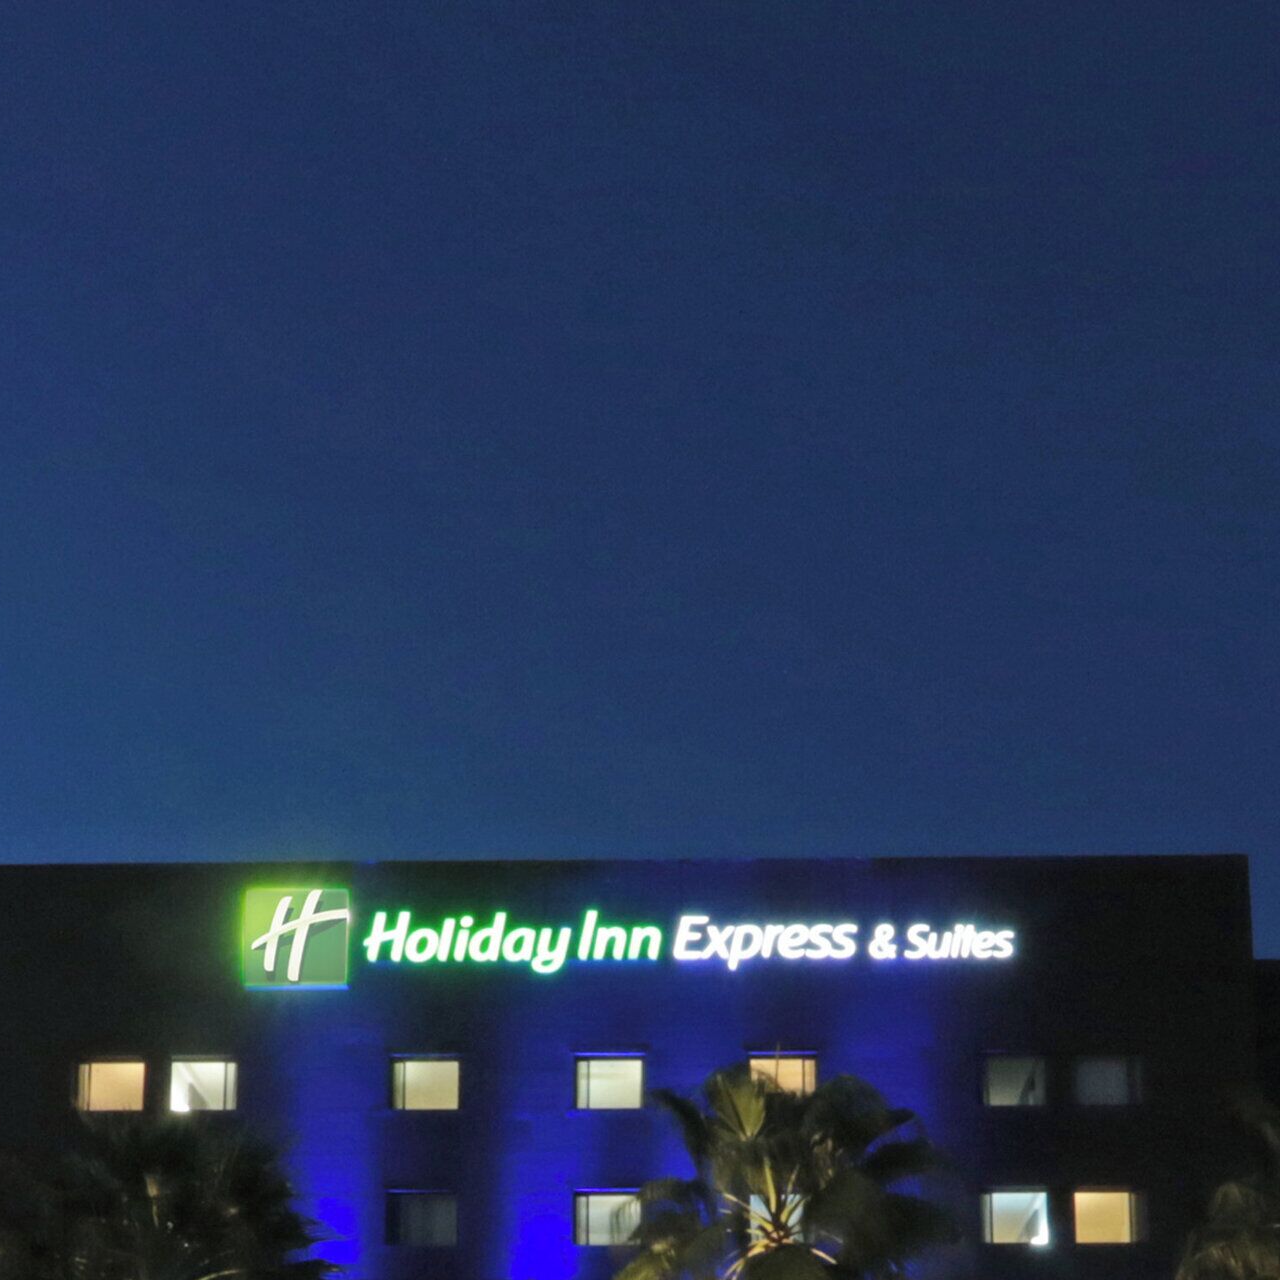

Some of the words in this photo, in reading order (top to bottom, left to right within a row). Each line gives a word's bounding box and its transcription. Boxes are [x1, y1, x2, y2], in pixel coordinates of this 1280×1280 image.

[363, 911, 572, 974] Holiday
[577, 909, 662, 961] Inn
[671, 913, 859, 972] Express
[867, 922, 899, 962] &
[902, 922, 1016, 961] Suites
